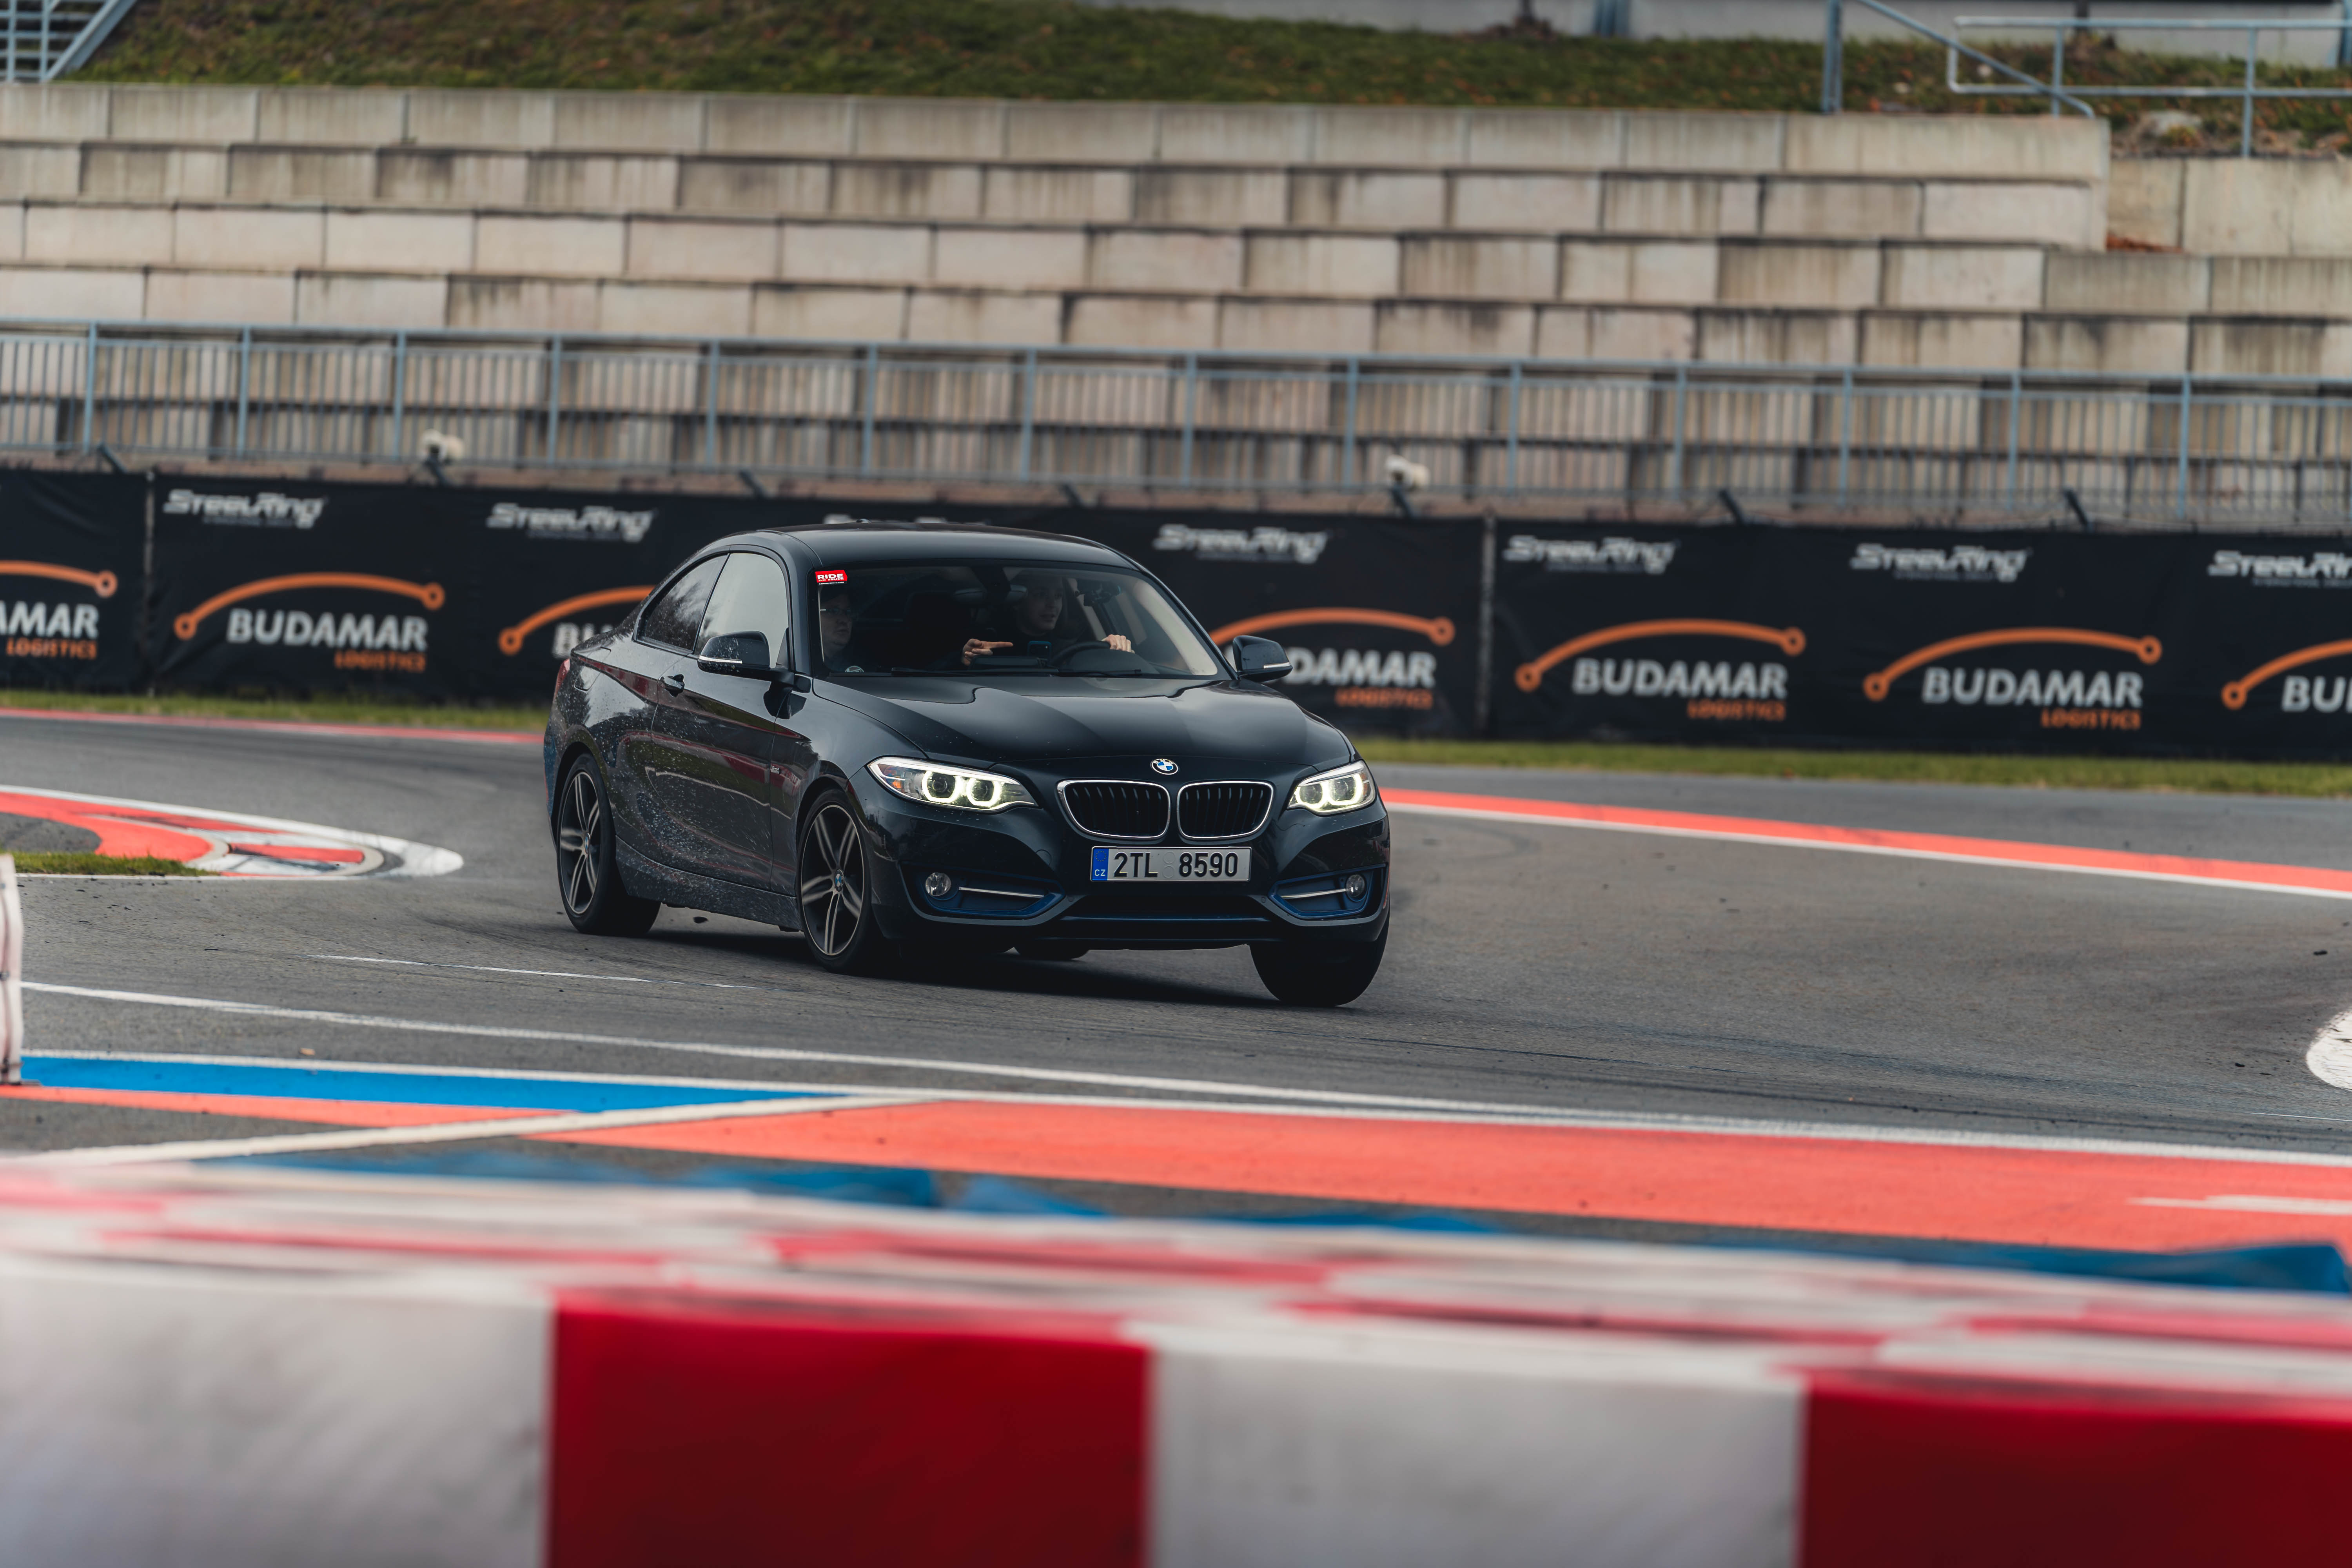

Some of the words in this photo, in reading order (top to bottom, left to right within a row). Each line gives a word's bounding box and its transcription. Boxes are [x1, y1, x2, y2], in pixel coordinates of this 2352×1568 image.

[227, 609, 428, 651] BUDAMAR
[6, 638, 97, 659] LOGISTICS
[335, 650, 426, 672] LOGISTICS
[1573, 659, 1788, 699] BUDAMAR
[1922, 668, 2143, 708] BUDAMAR
[2281, 675, 2352, 713] BU
[2041, 709, 2141, 729] LOGISTICS
[1114, 851, 1158, 877] 2TL
[1179, 851, 1238, 877] 8590
